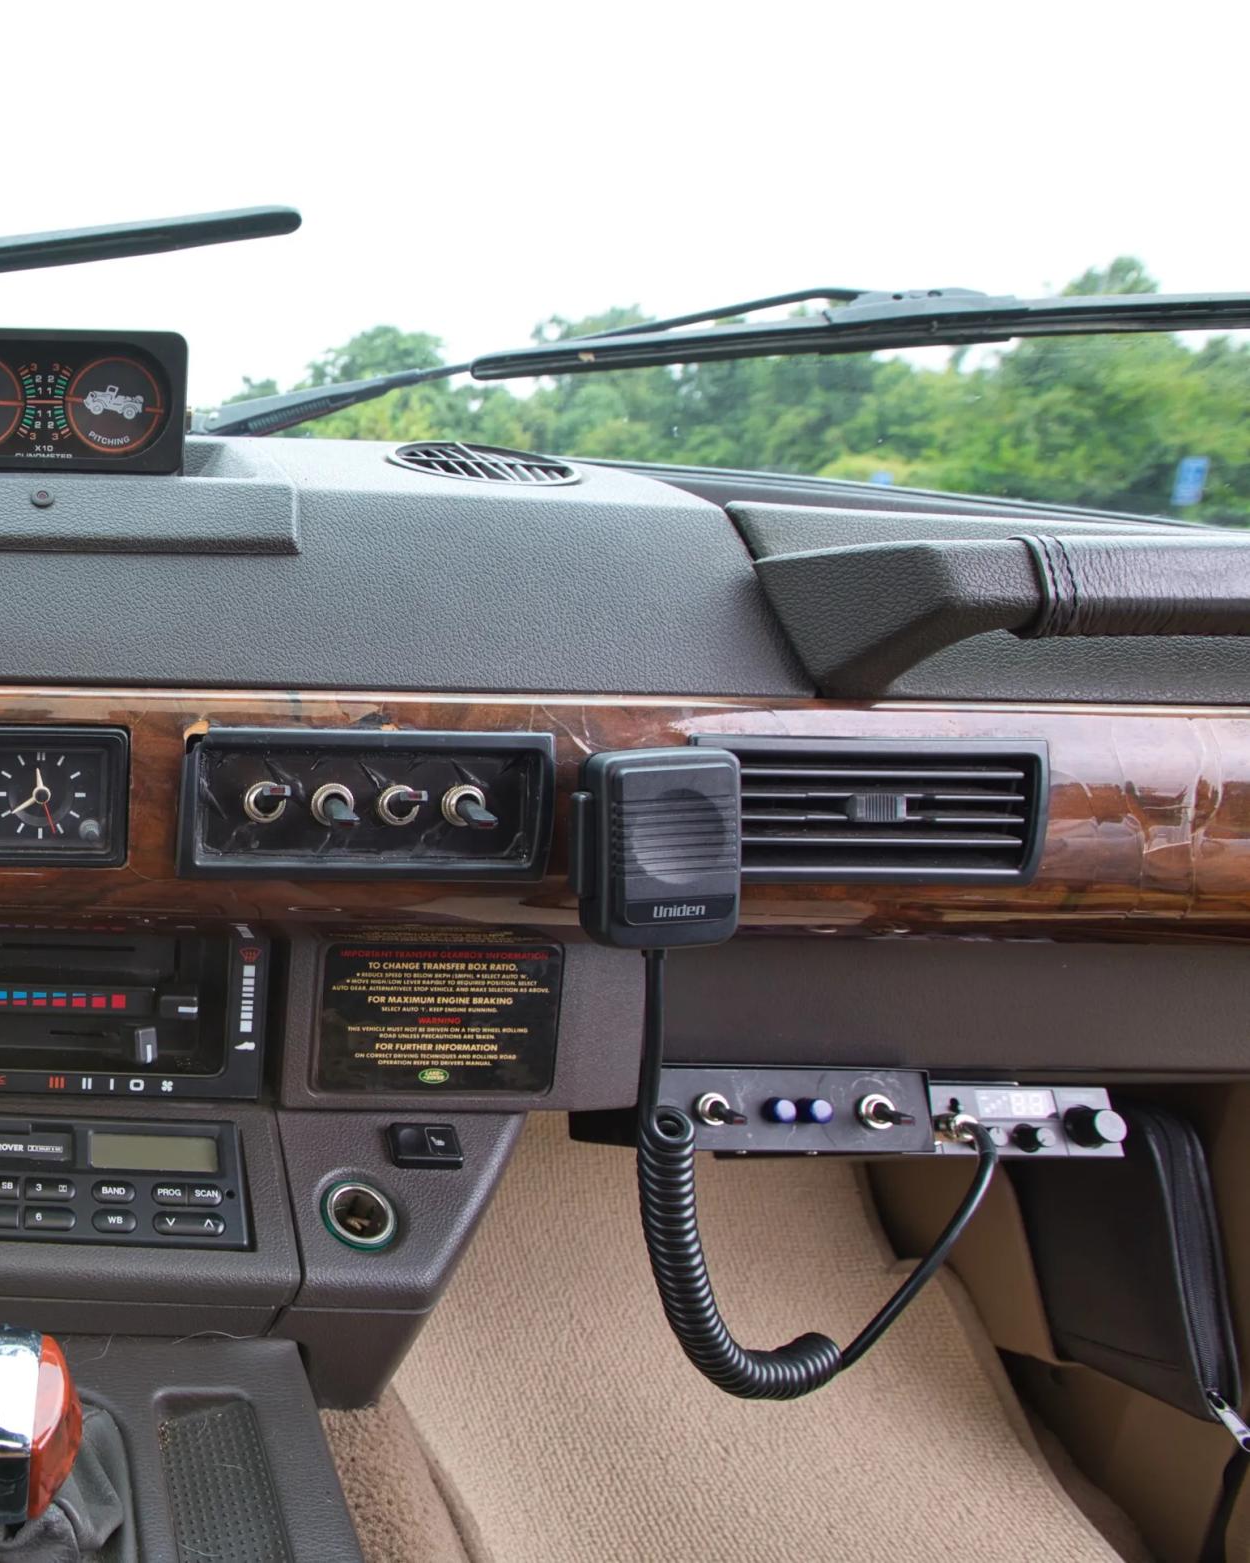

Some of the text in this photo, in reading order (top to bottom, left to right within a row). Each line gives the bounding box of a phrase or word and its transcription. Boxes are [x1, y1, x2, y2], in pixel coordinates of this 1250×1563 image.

[30, 363, 37, 371] 3
[53, 363, 60, 371] 3
[35, 375, 42, 383] 2
[48, 375, 55, 383] 2
[37, 387, 42, 395] 1
[47, 387, 51, 395] 1
[88, 431, 131, 445] PITCHING
[653, 904, 705, 917] Uniden
[486, 951, 547, 959] INFORMATION
[382, 962, 419, 970] CHANGE
[423, 963, 465, 971] TRANSFER
[468, 963, 487, 971] BOX
[473, 997, 513, 1005] BRAKING
[375, 1043, 393, 1051] FOR
[395, 1043, 433, 1051] FURTHER
[102, 1187, 125, 1195] BAND
[158, 1188, 181, 1196] PROG
[195, 1189, 218, 1197] SCAN
[36, 1213, 42, 1221] 6
[108, 1216, 123, 1224] WB
